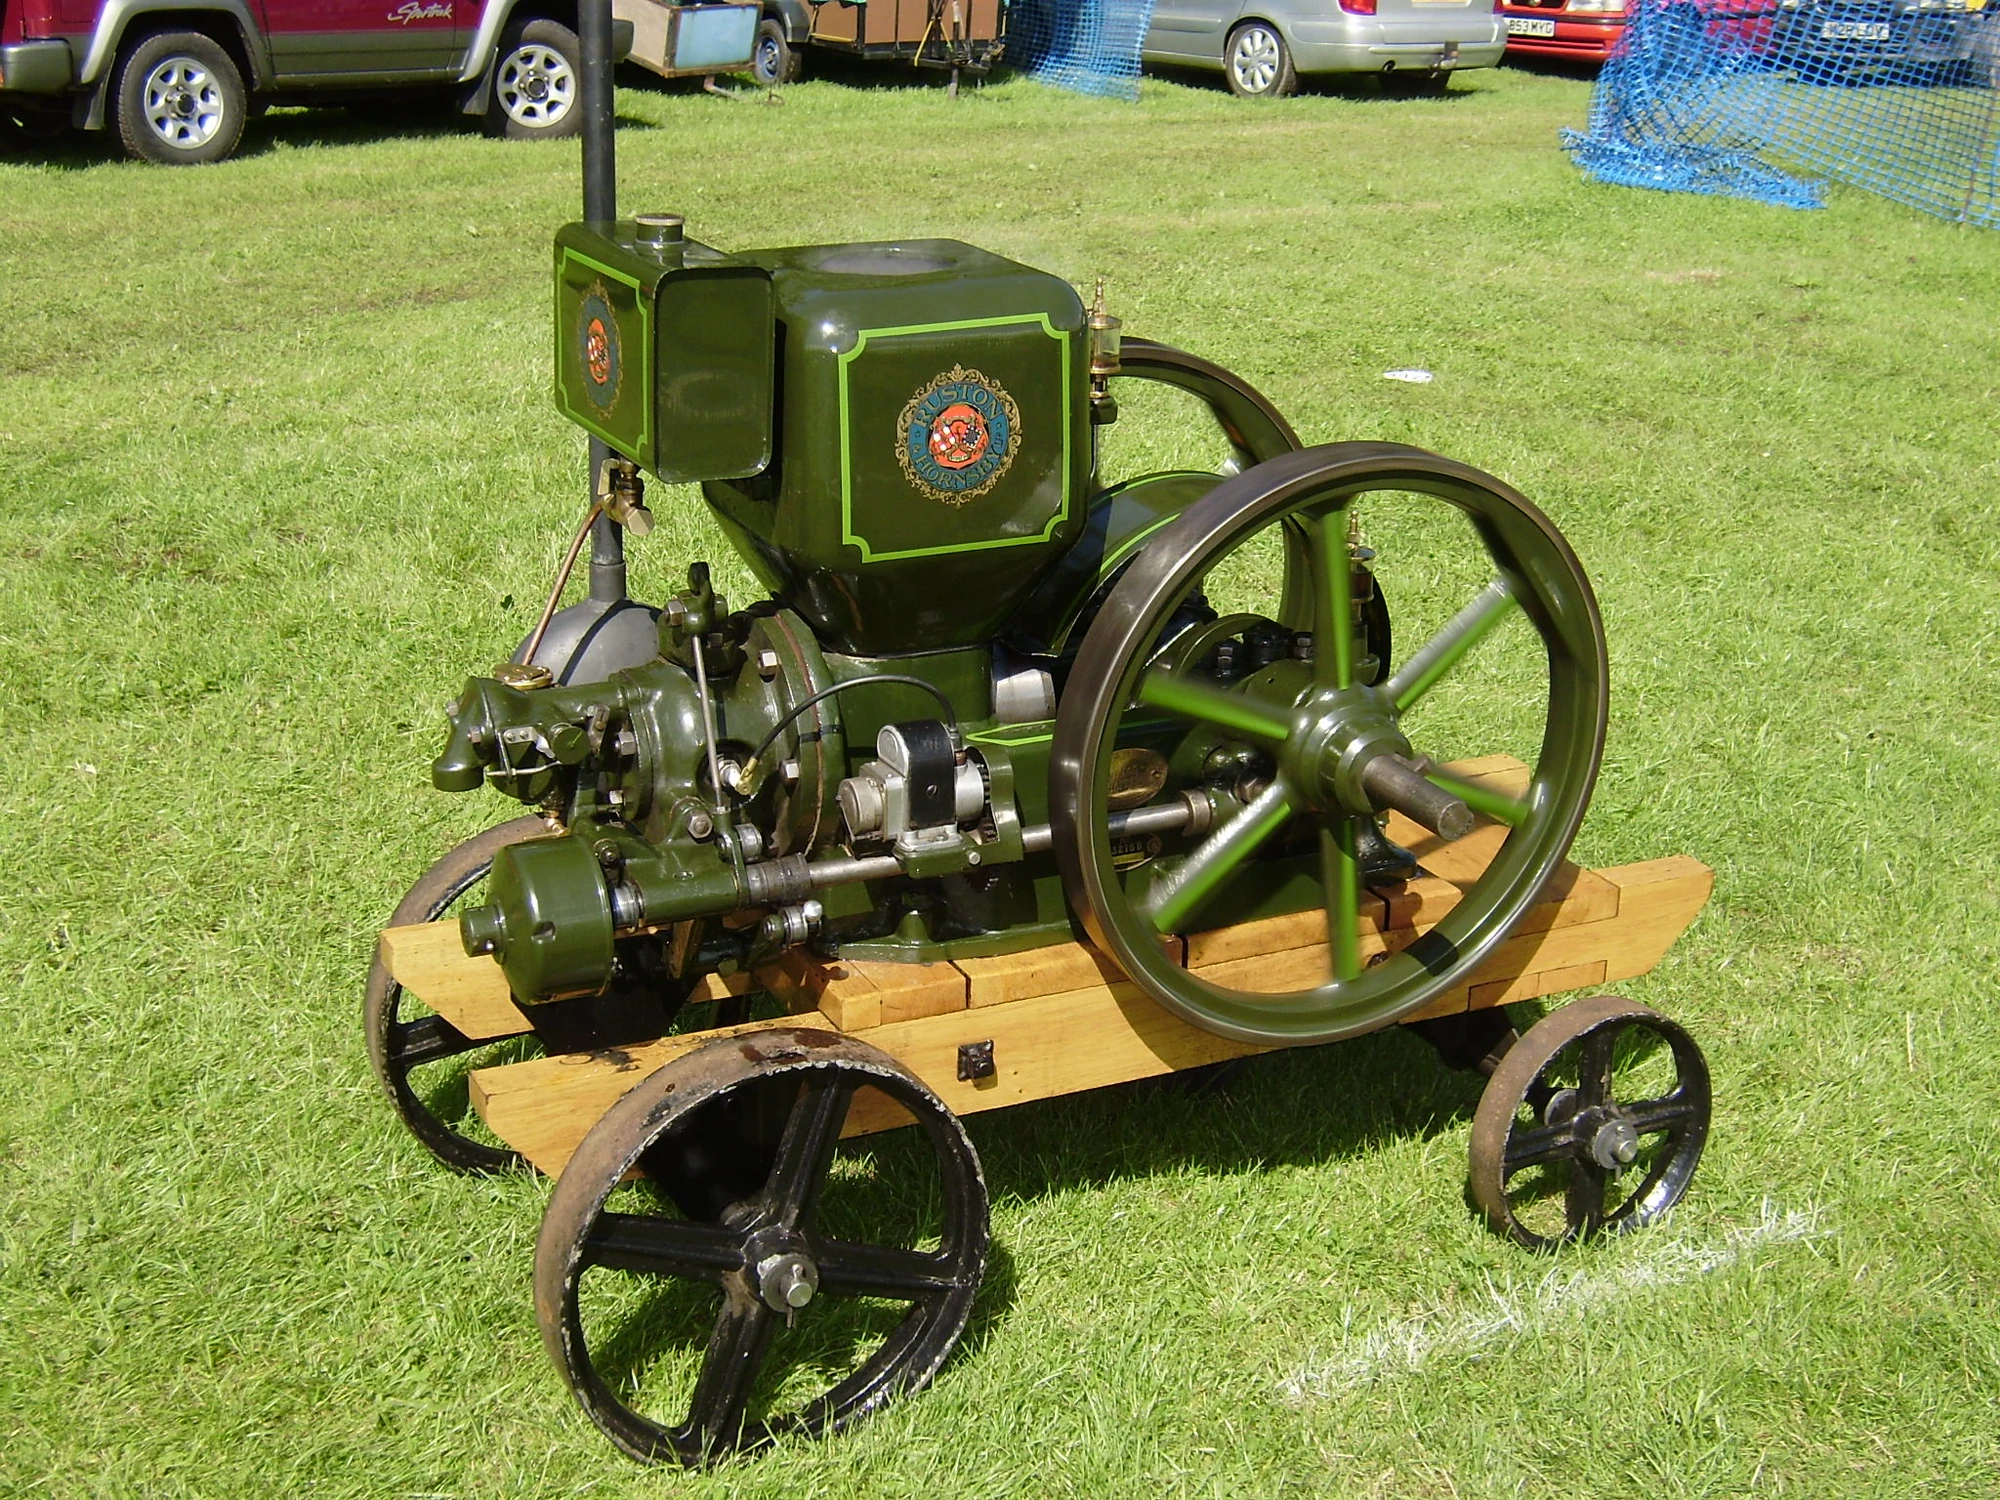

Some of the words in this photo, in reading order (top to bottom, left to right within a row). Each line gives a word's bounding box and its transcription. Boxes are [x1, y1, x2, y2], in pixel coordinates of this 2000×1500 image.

[387, 1, 453, 25] Sportrak
[1531, 22, 1553, 34] MYG
[914, 383, 1003, 428] RUSTON
[915, 445, 1002, 489] HORNSBY
